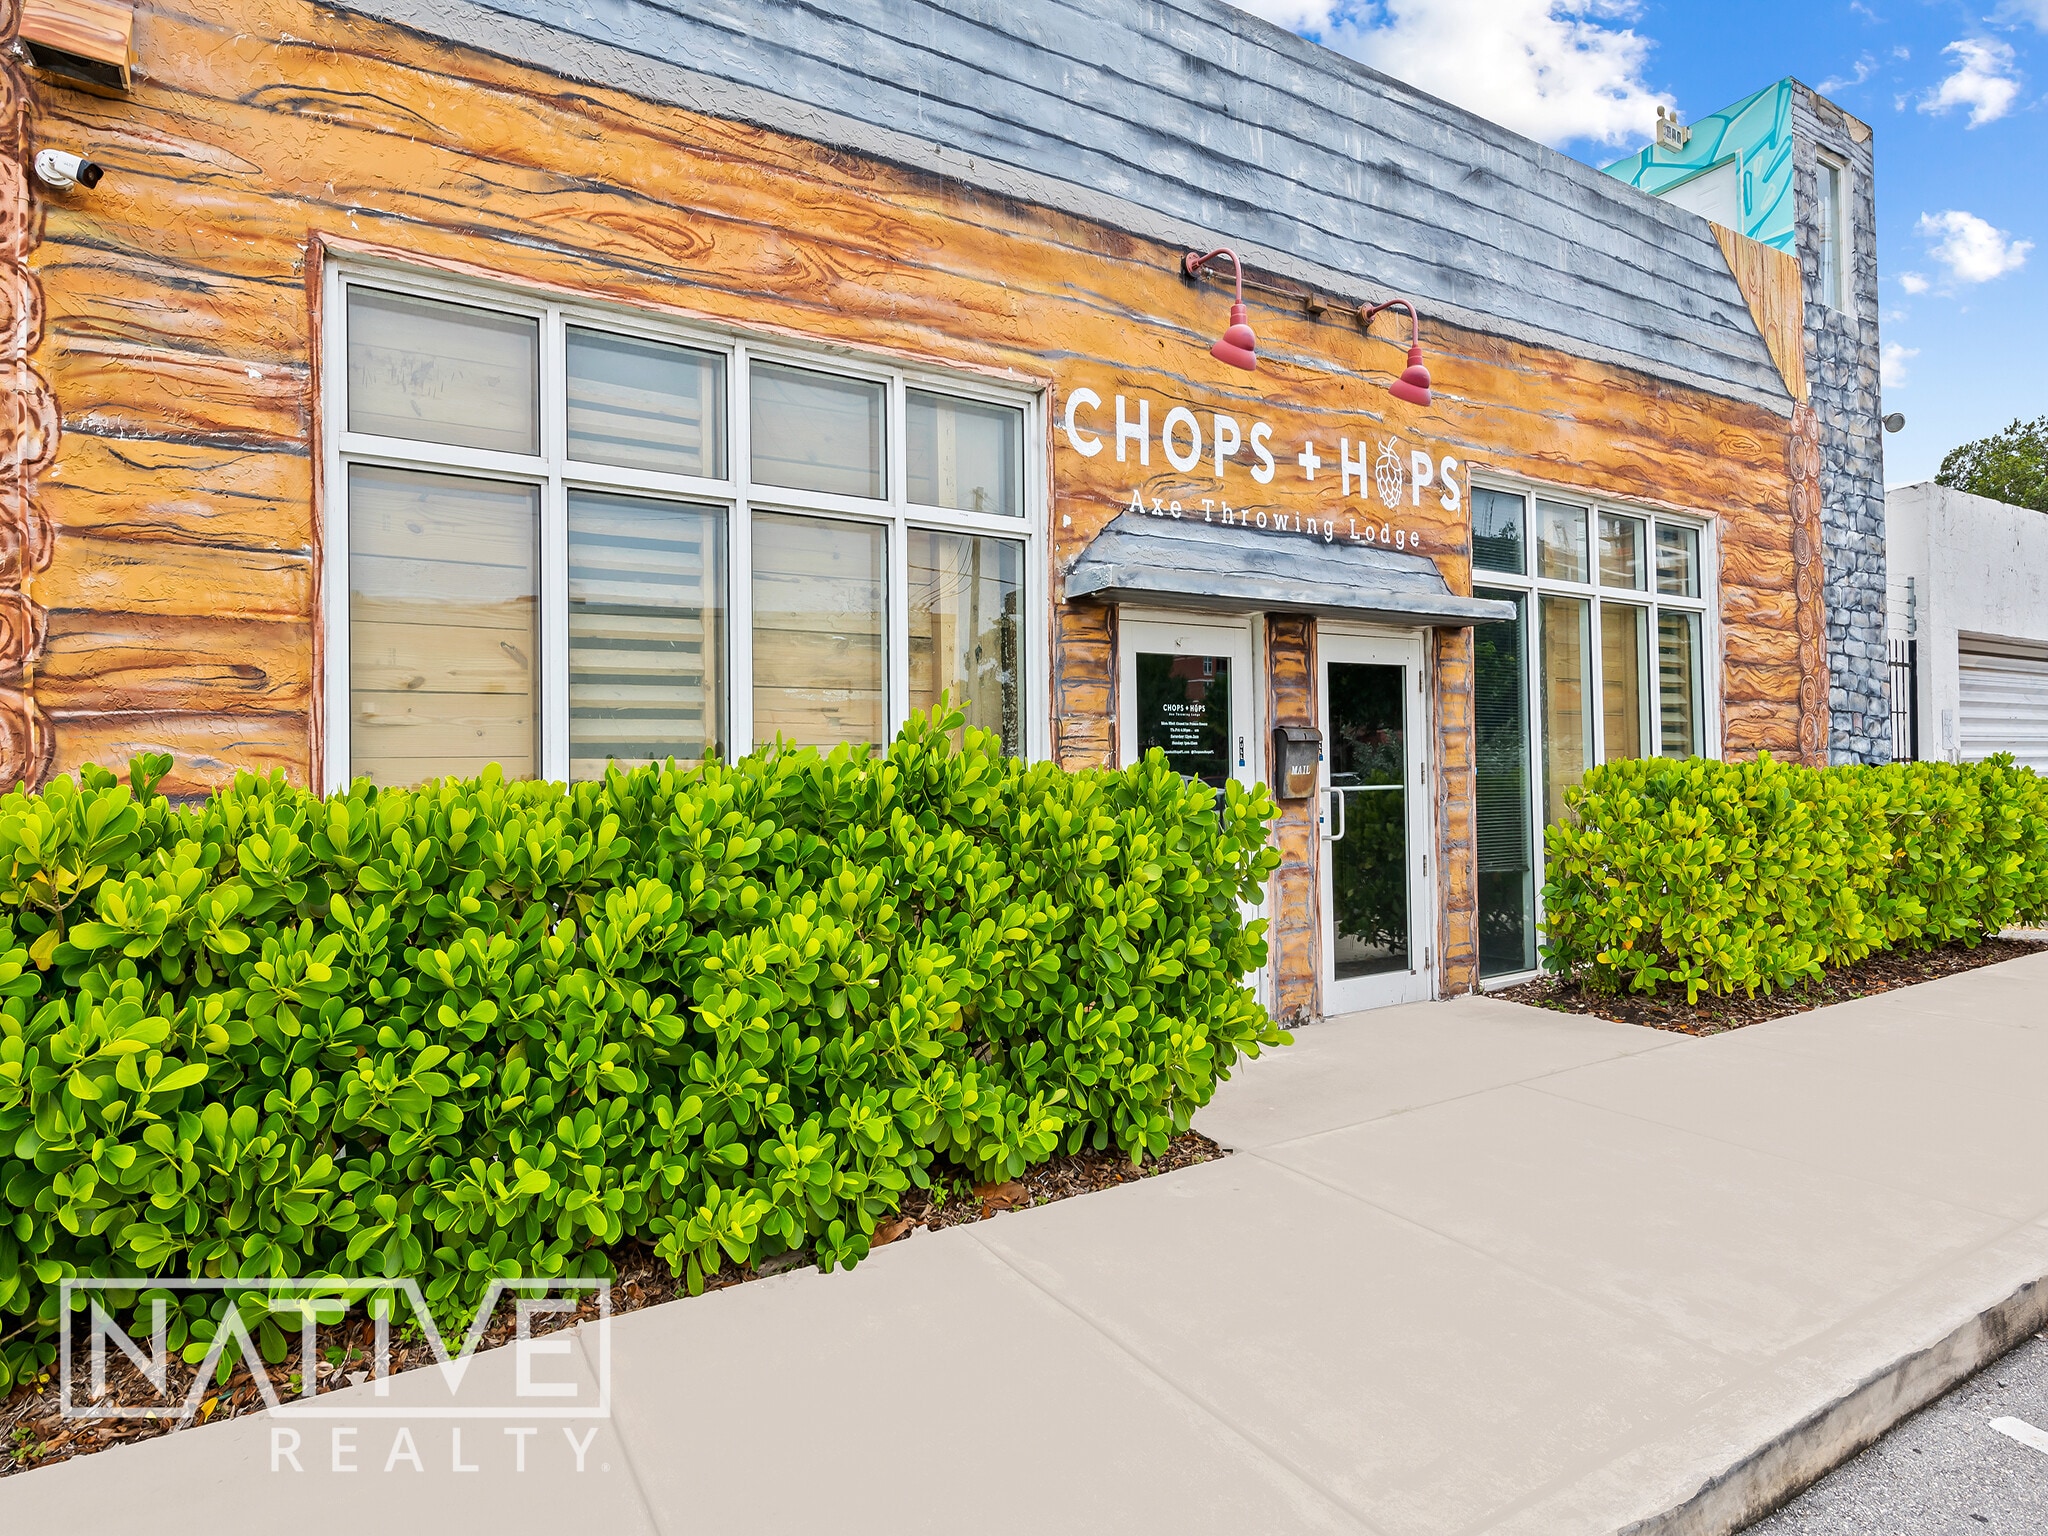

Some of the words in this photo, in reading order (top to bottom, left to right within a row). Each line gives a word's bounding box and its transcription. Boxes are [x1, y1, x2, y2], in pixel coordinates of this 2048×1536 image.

[1064, 387, 1275, 484] CHOPS
[1129, 489, 1182, 518] Axe
[1201, 498, 1334, 543] Throwing
[1350, 518, 1420, 550] Lodge
[1162, 703, 1184, 712] CHOPS
[1290, 765, 1311, 775] MAIL
